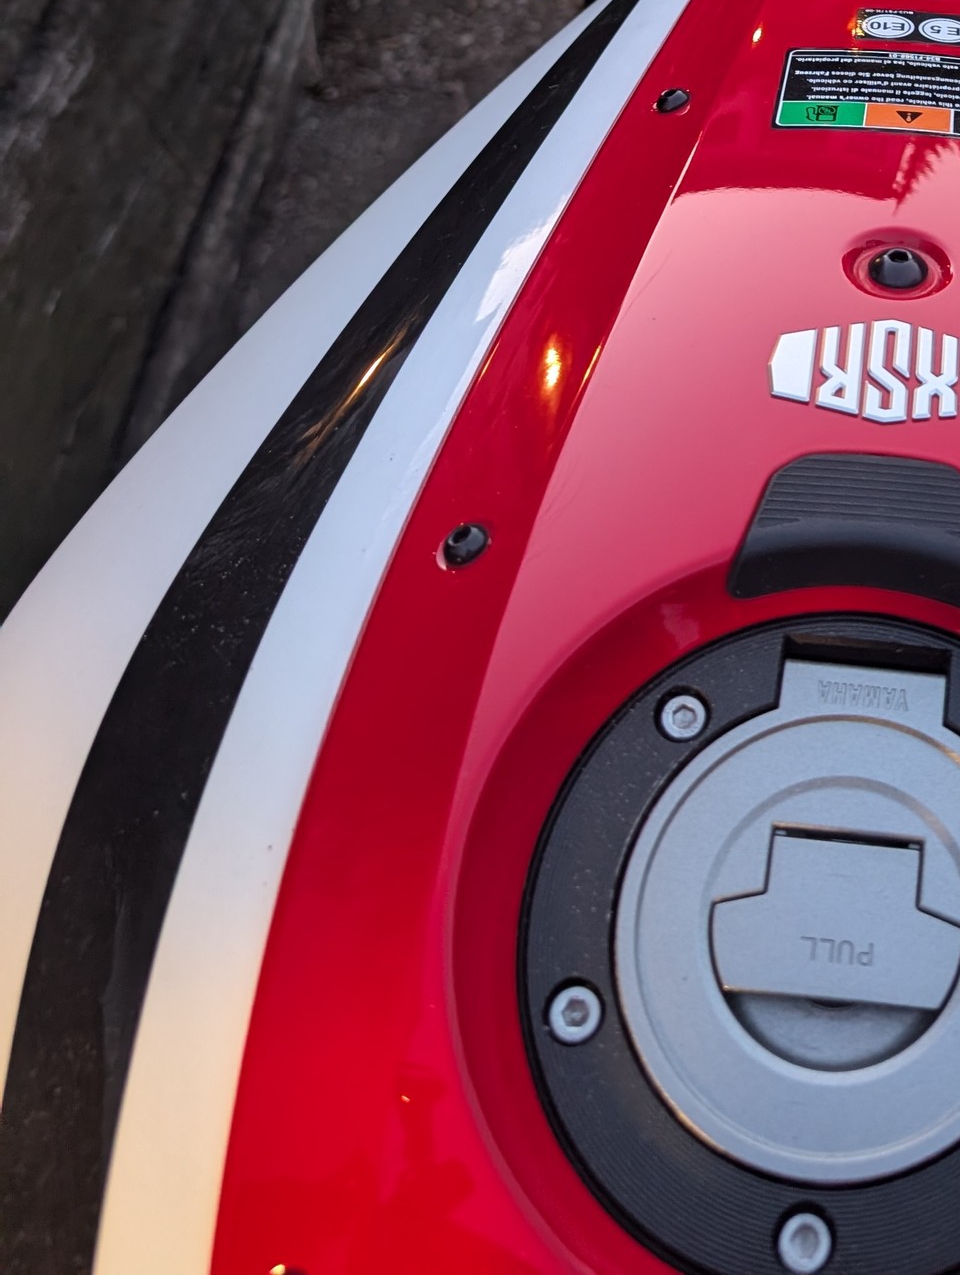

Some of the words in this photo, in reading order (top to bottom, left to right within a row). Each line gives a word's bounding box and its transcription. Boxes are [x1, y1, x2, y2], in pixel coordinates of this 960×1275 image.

[870, 21, 905, 31] E10
[860, 87, 894, 95] manuale
[906, 98, 937, 106] vehicle,
[815, 318, 959, 425] XSR
[818, 680, 909, 712] YAMAHA
[800, 936, 875, 967] PULL
